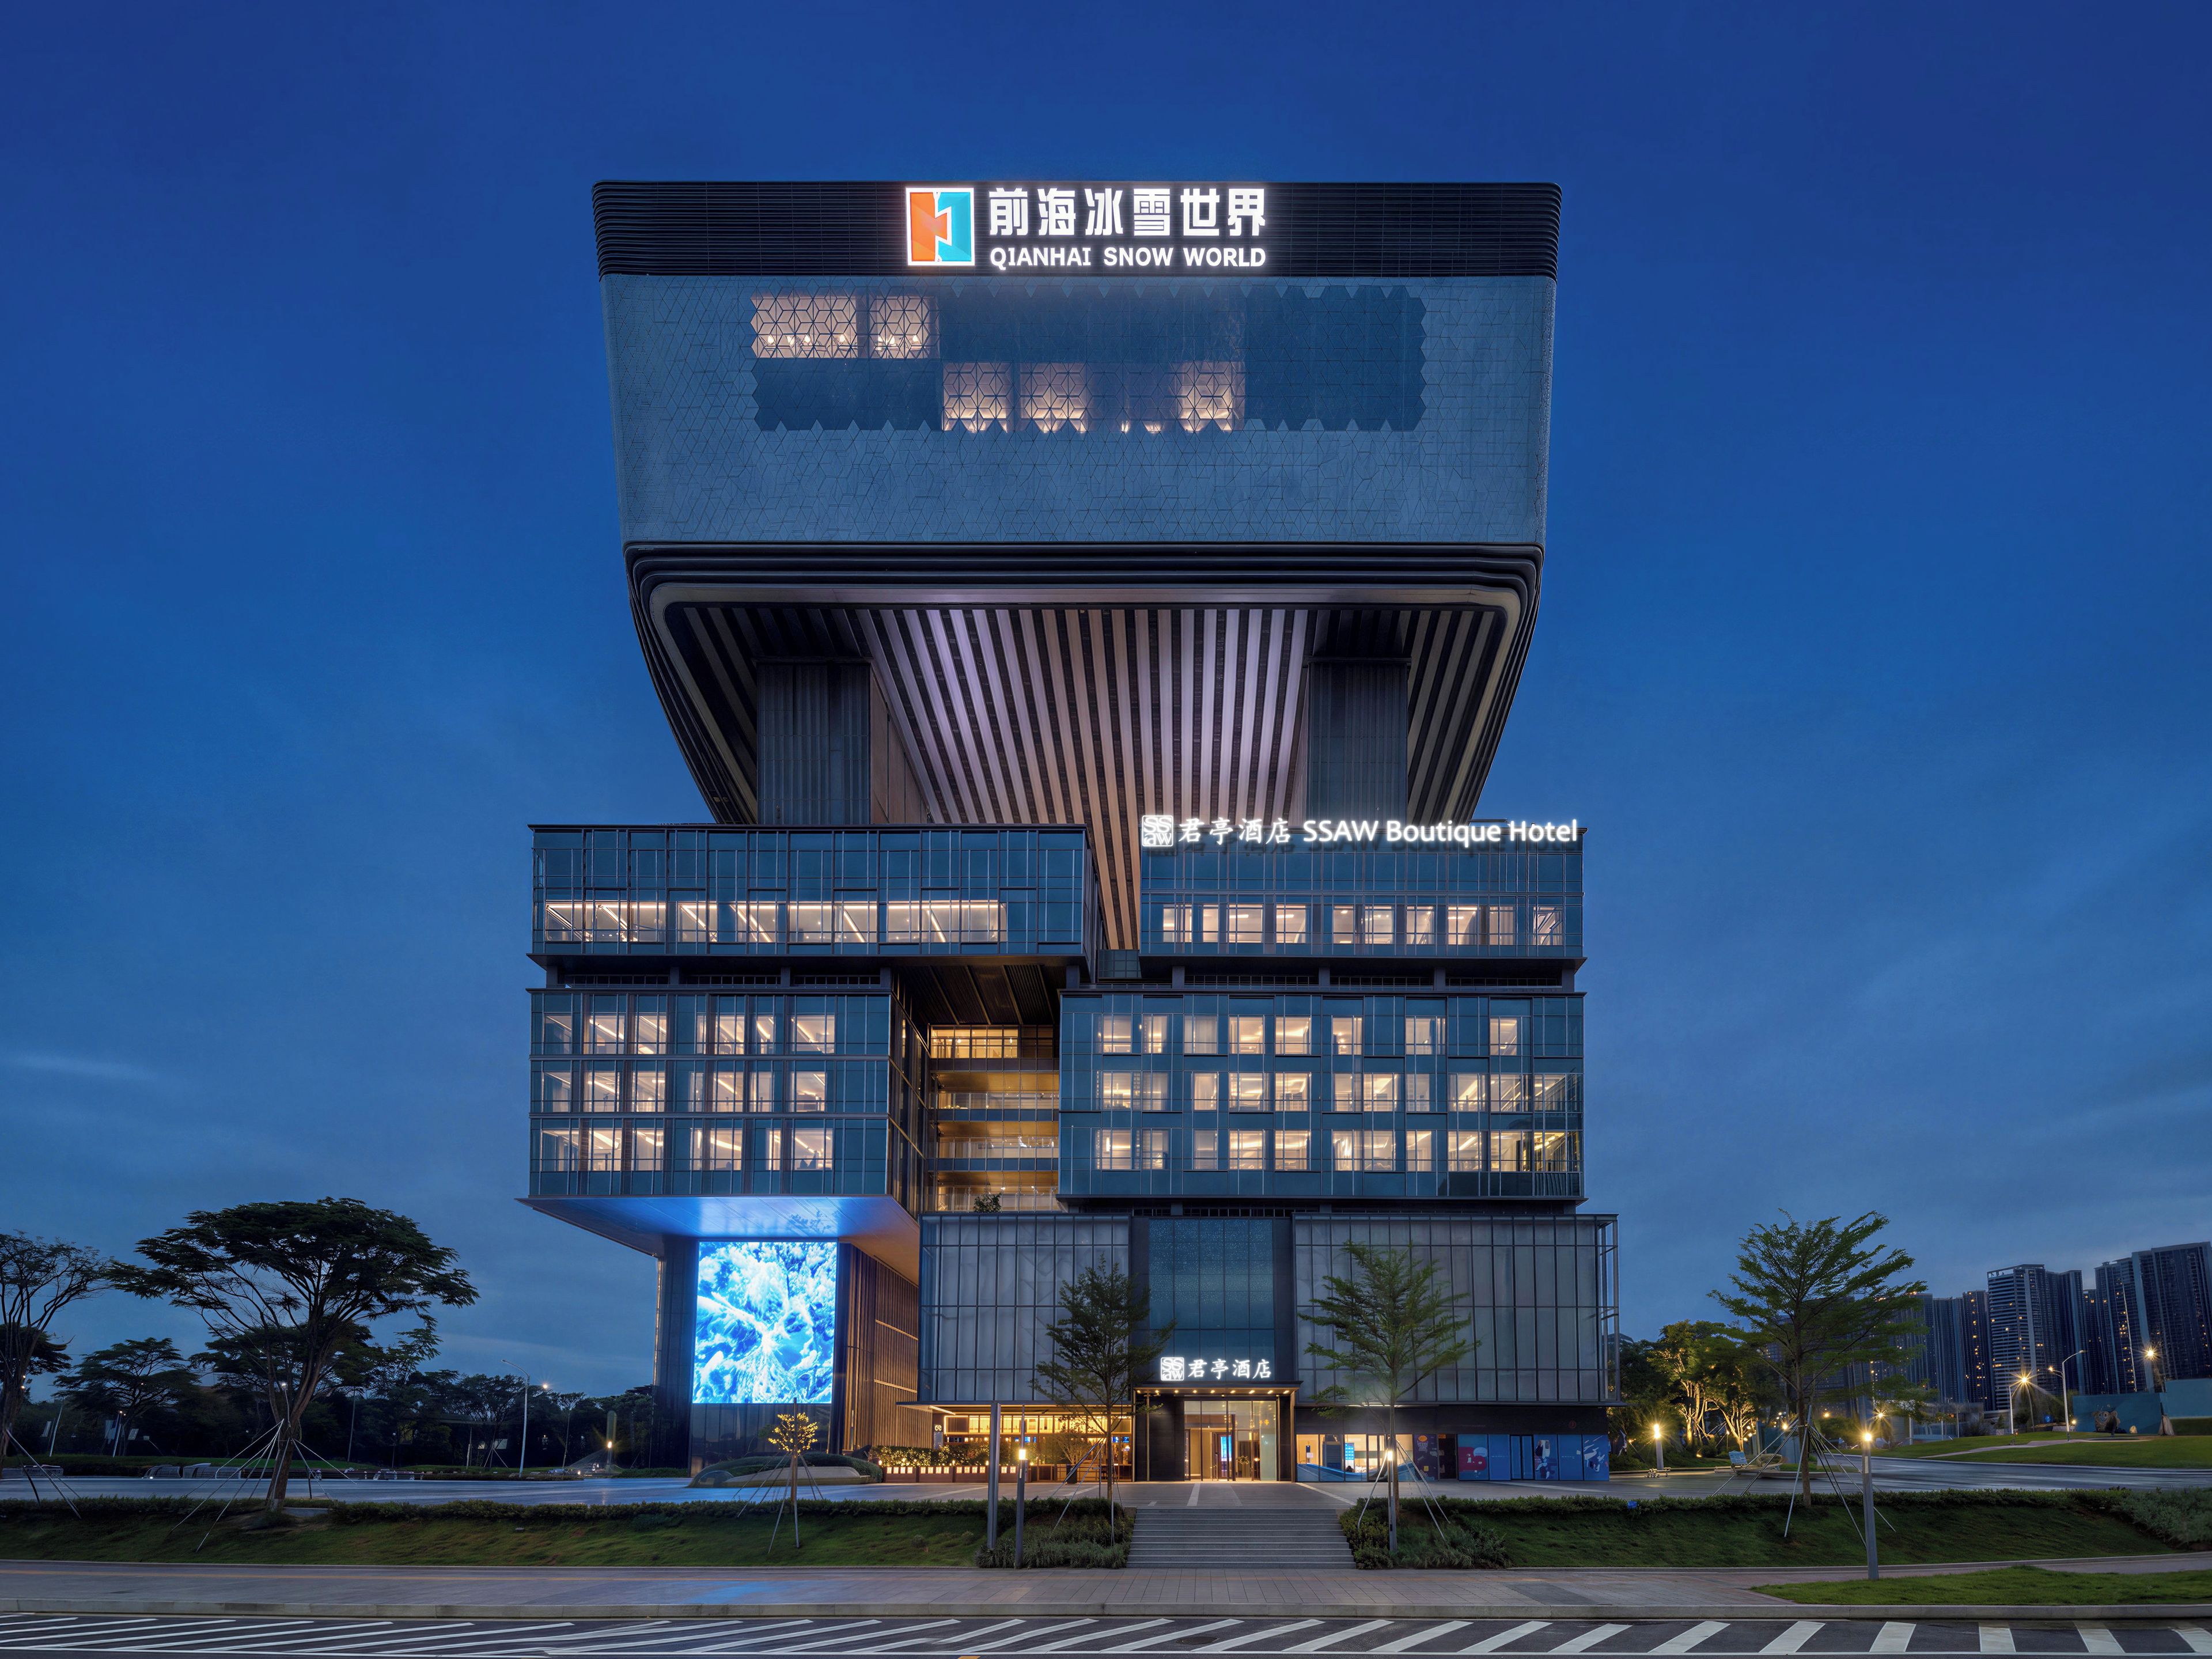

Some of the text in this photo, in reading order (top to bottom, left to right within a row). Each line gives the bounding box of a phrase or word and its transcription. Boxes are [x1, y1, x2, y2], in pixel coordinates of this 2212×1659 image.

[989, 187, 1266, 236] 前海冰雪世界
[990, 247, 1266, 271] QIANHAI SNOW WORLD
[1178, 817, 1290, 845] 君亭酒店
[1302, 819, 1578, 848] SSAW Boutique Hotel
[1188, 1358, 1271, 1380] 君亭酒店
